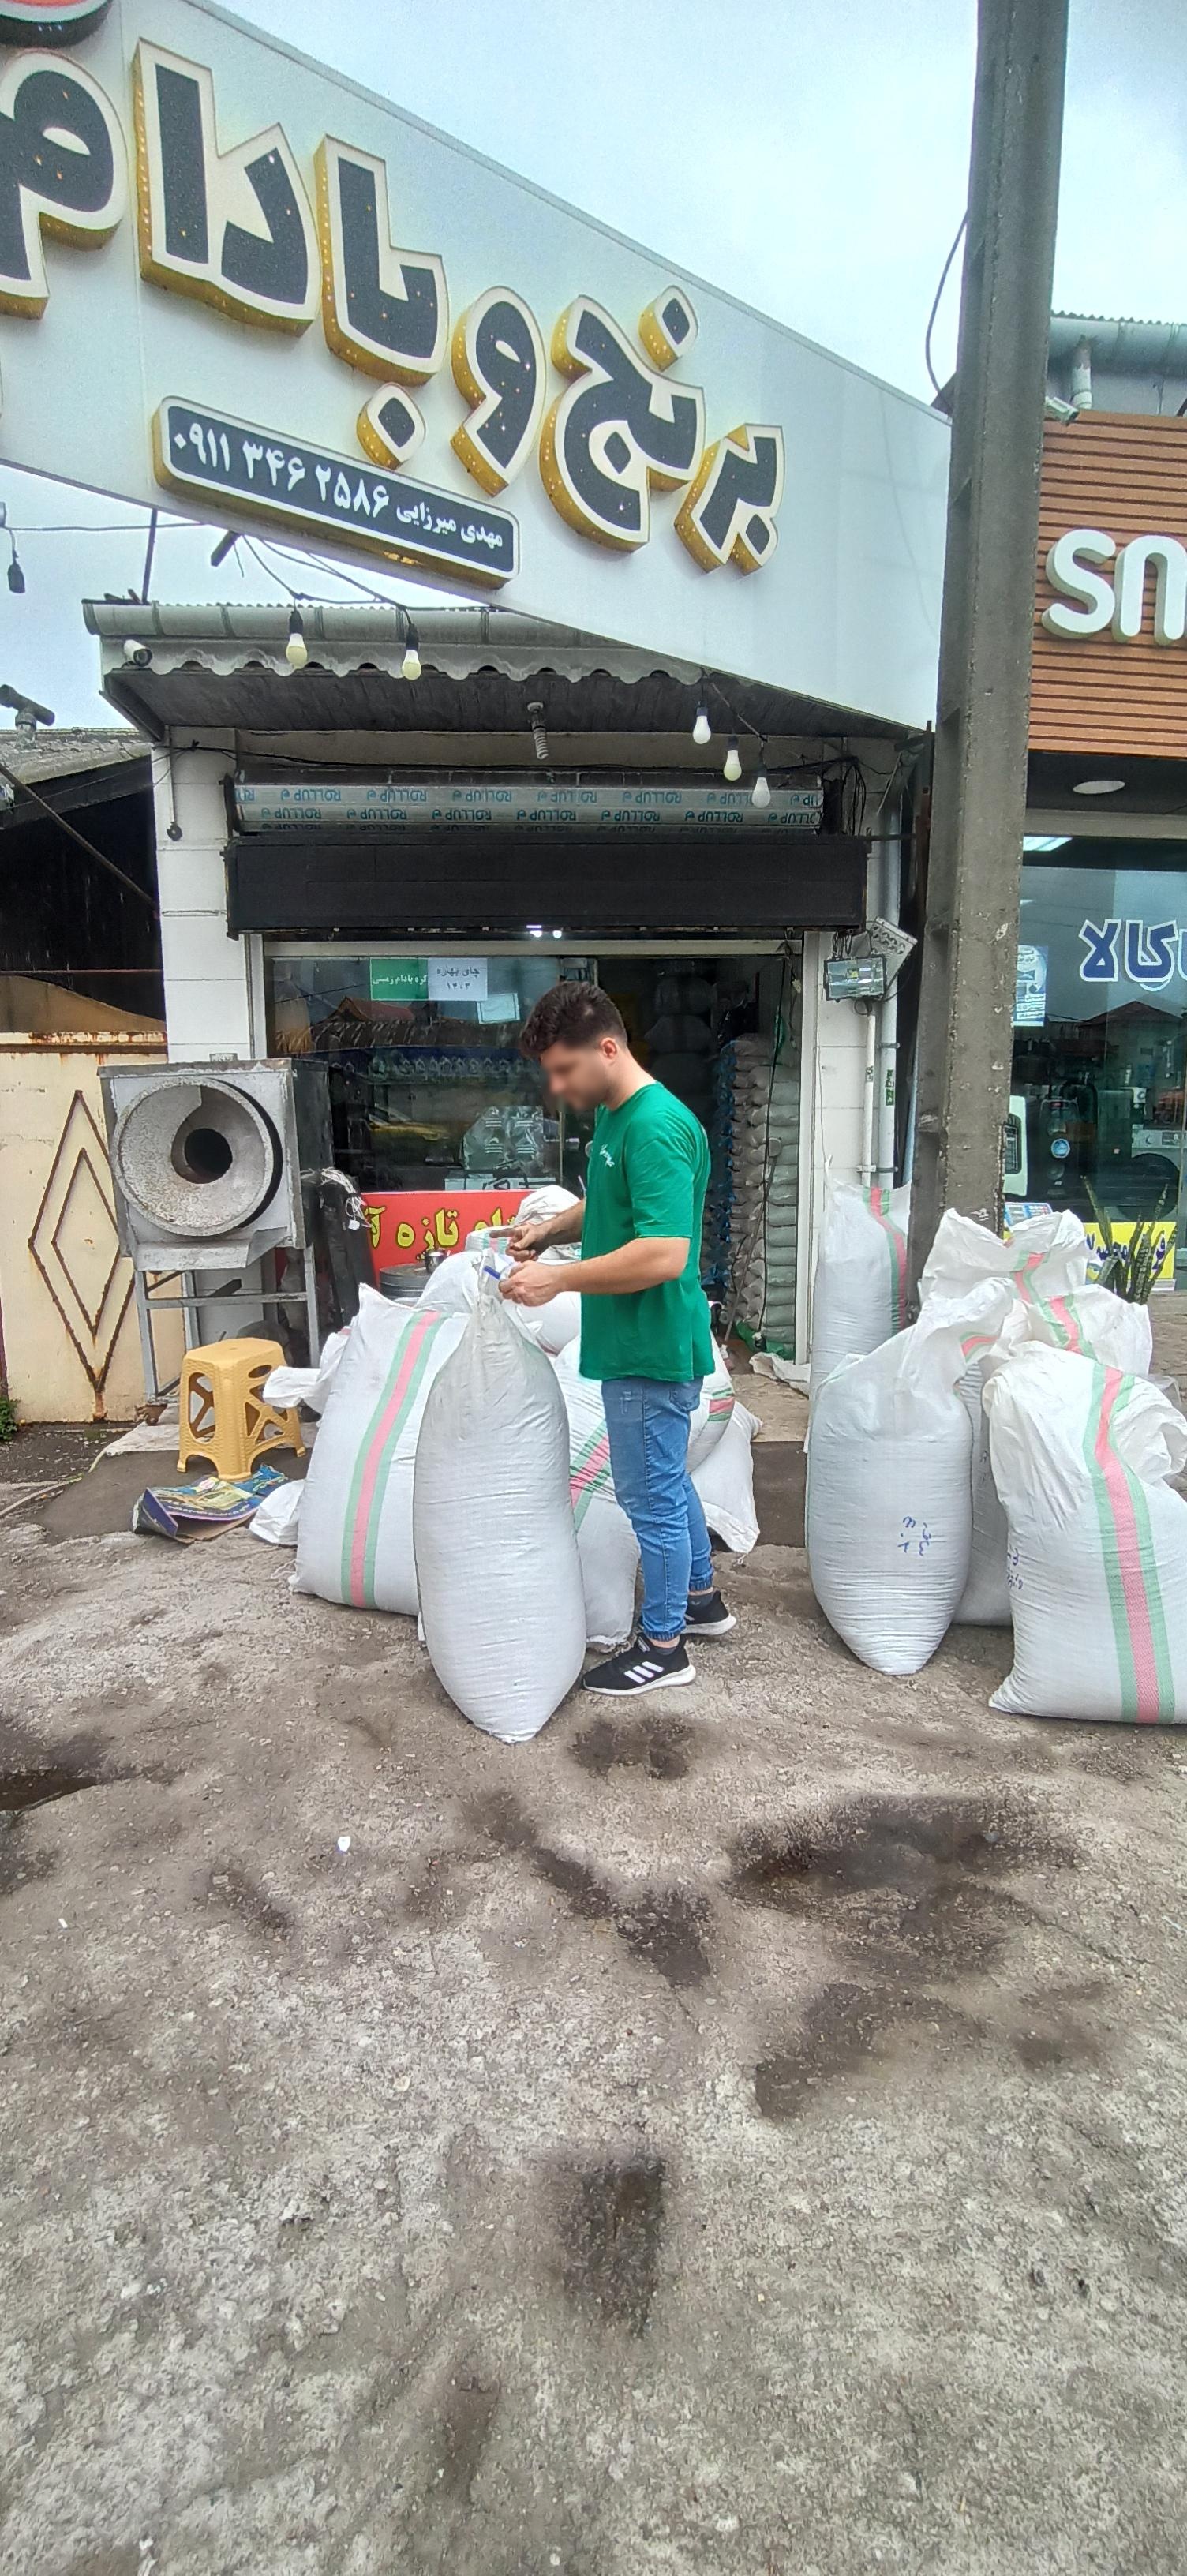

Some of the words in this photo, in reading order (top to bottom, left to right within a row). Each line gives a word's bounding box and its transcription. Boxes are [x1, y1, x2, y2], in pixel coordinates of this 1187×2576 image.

[0, 37, 449, 469] بادام
[455, 285, 546, 492] و
[548, 284, 784, 571] برنج
[173, 422, 231, 472] ۰۹۱۱
[242, 440, 305, 492] ۳۴۶
[315, 464, 390, 519] ۲۵۸۶
[396, 500, 457, 535] میرزایی
[461, 524, 504, 549] مهدی
[1043, 528, 1187, 642] sn
[719, 792, 752, 805] LLUP
[395, 974, 414, 985] بادام
[462, 966, 481, 979] چای
